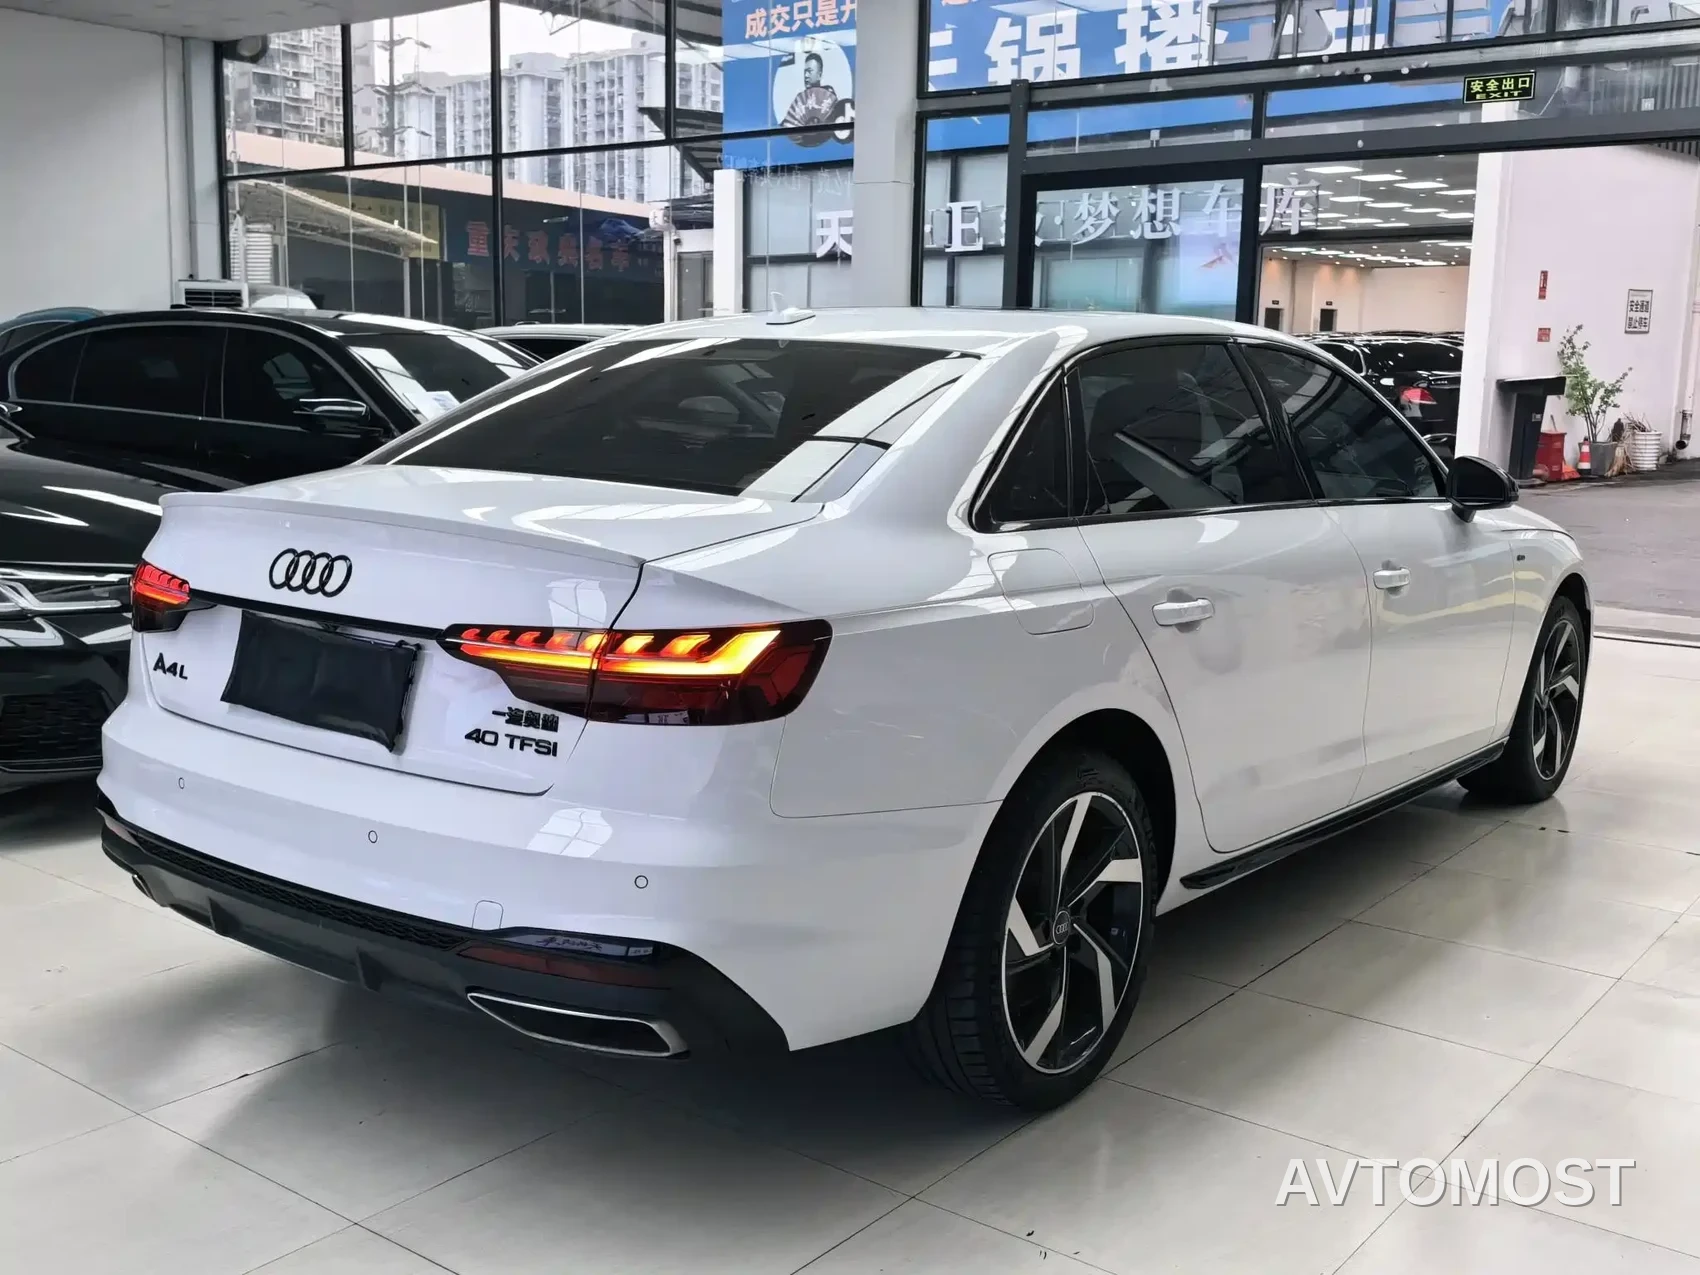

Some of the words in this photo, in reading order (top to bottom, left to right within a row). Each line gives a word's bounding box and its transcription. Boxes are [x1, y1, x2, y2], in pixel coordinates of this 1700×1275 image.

[1470, 77, 1530, 93] 安全出口
[1475, 90, 1523, 100] EXIT
[153, 652, 188, 680] A4L
[464, 728, 499, 746] 40
[504, 733, 558, 757] TFSI
